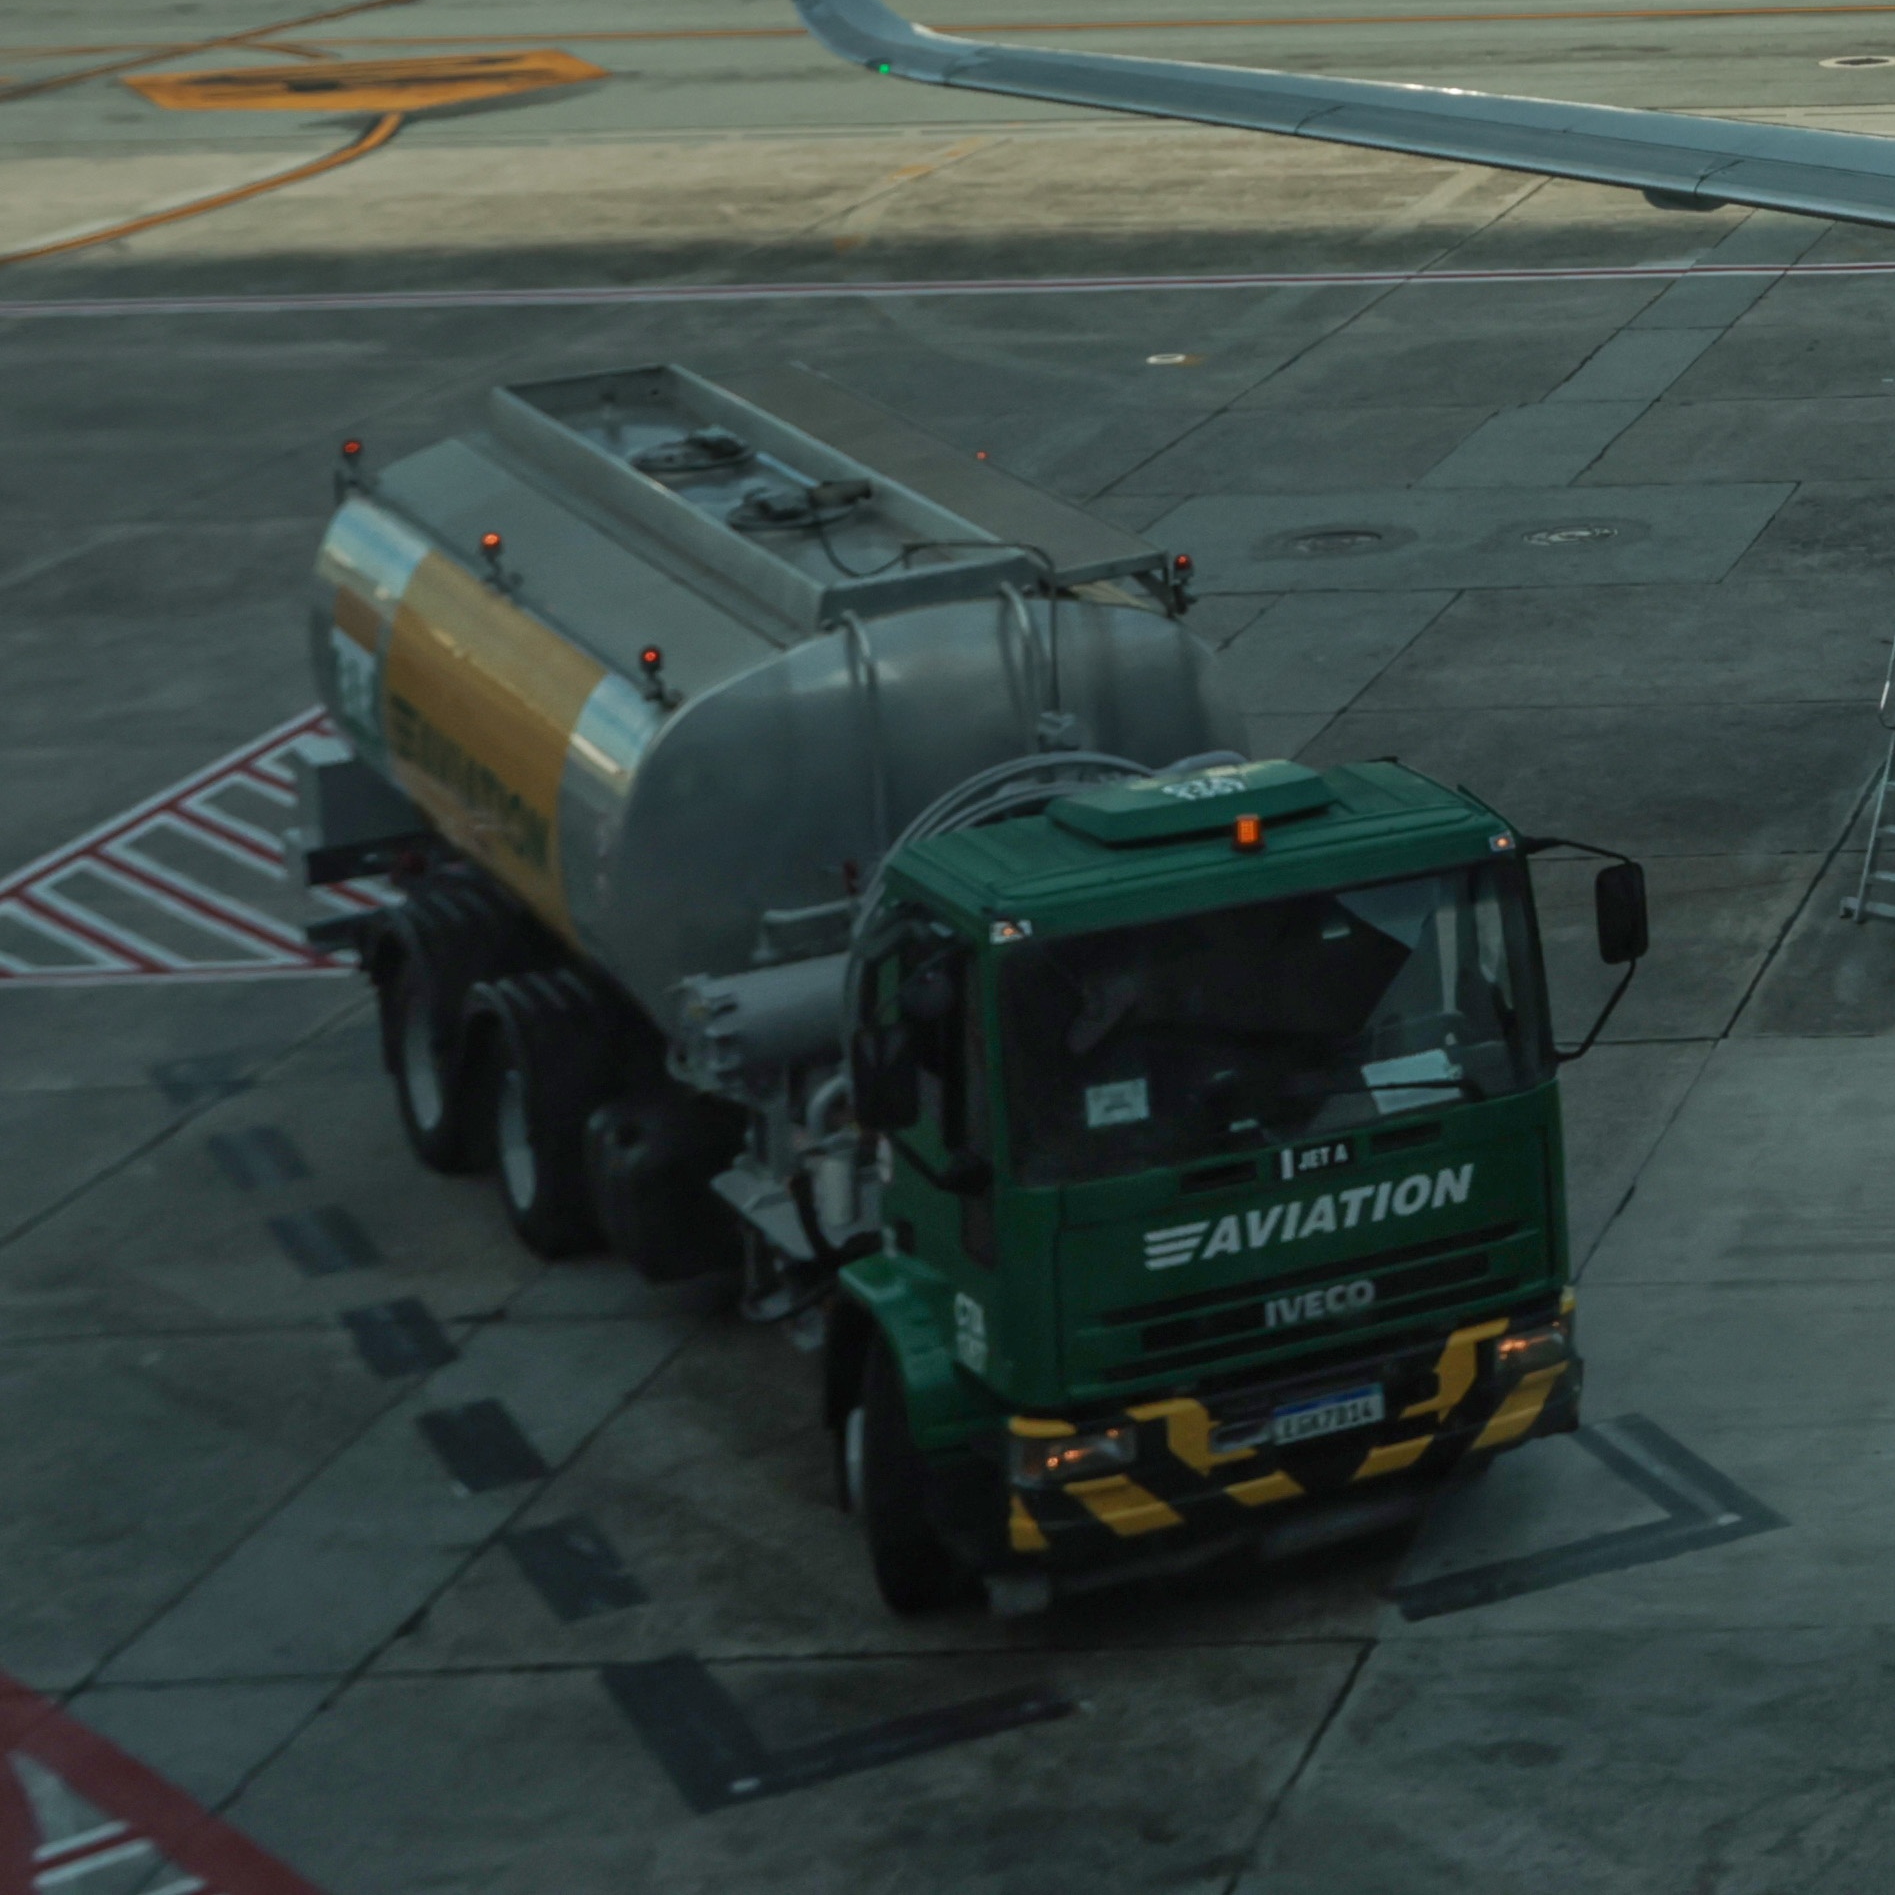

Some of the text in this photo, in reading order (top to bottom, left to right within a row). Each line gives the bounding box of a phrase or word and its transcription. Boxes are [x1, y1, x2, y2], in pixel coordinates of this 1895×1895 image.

[1298, 1143, 1349, 1171] JET A
[1201, 1163, 1475, 1260] AVIATION
[1264, 1280, 1377, 1328] IVECO
